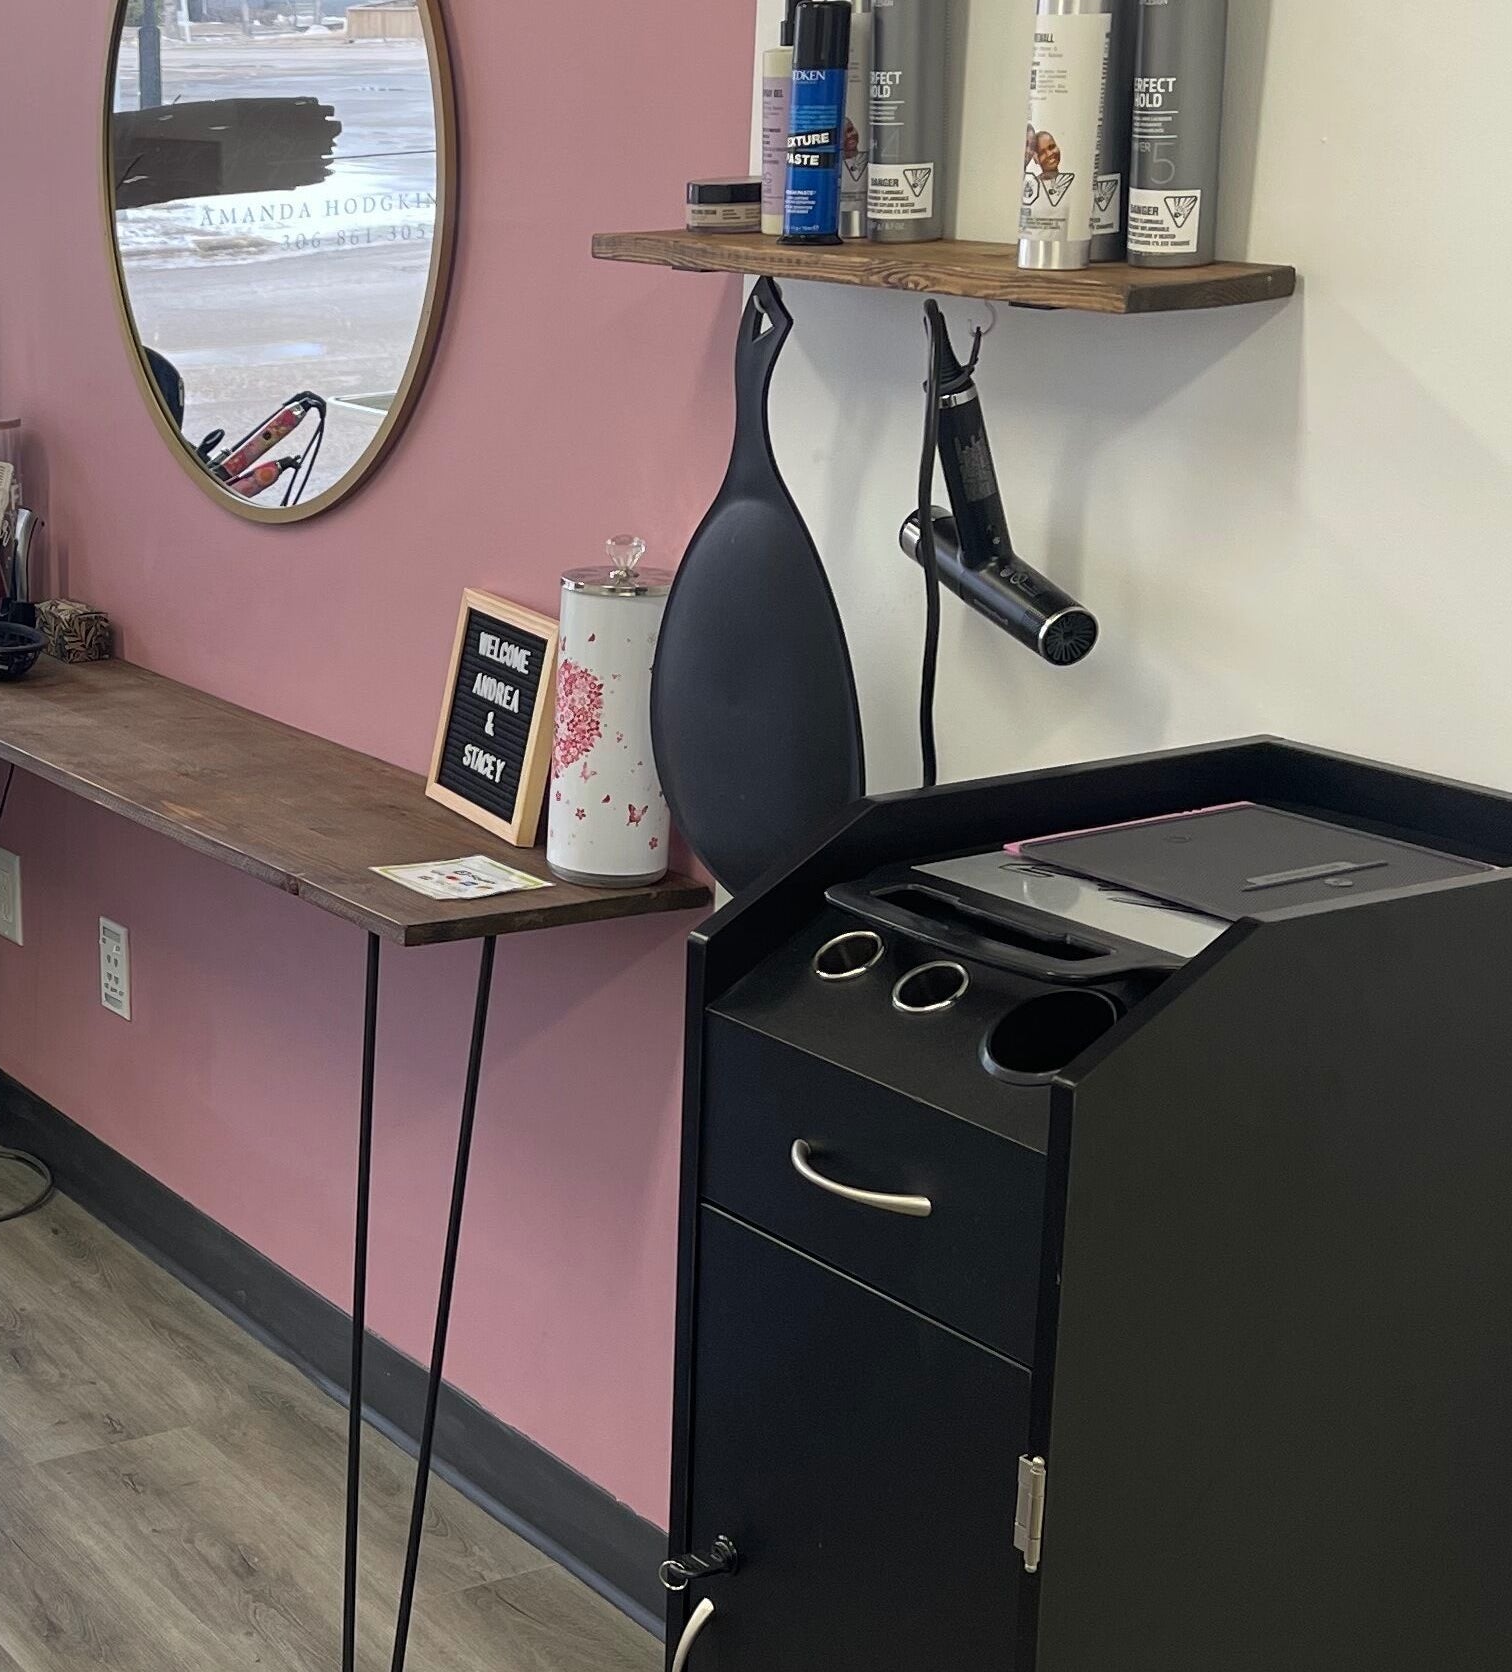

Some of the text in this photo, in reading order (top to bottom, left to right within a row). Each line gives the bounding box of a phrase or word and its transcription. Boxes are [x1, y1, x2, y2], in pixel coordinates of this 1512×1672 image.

[1150, 141, 1175, 185] 5
[199, 192, 437, 227] AMANDA HODGKIN
[478, 631, 532, 675] WELCOME
[472, 672, 520, 714] ANDREA
[484, 711, 495, 737] &
[462, 743, 506, 784] STACEY
